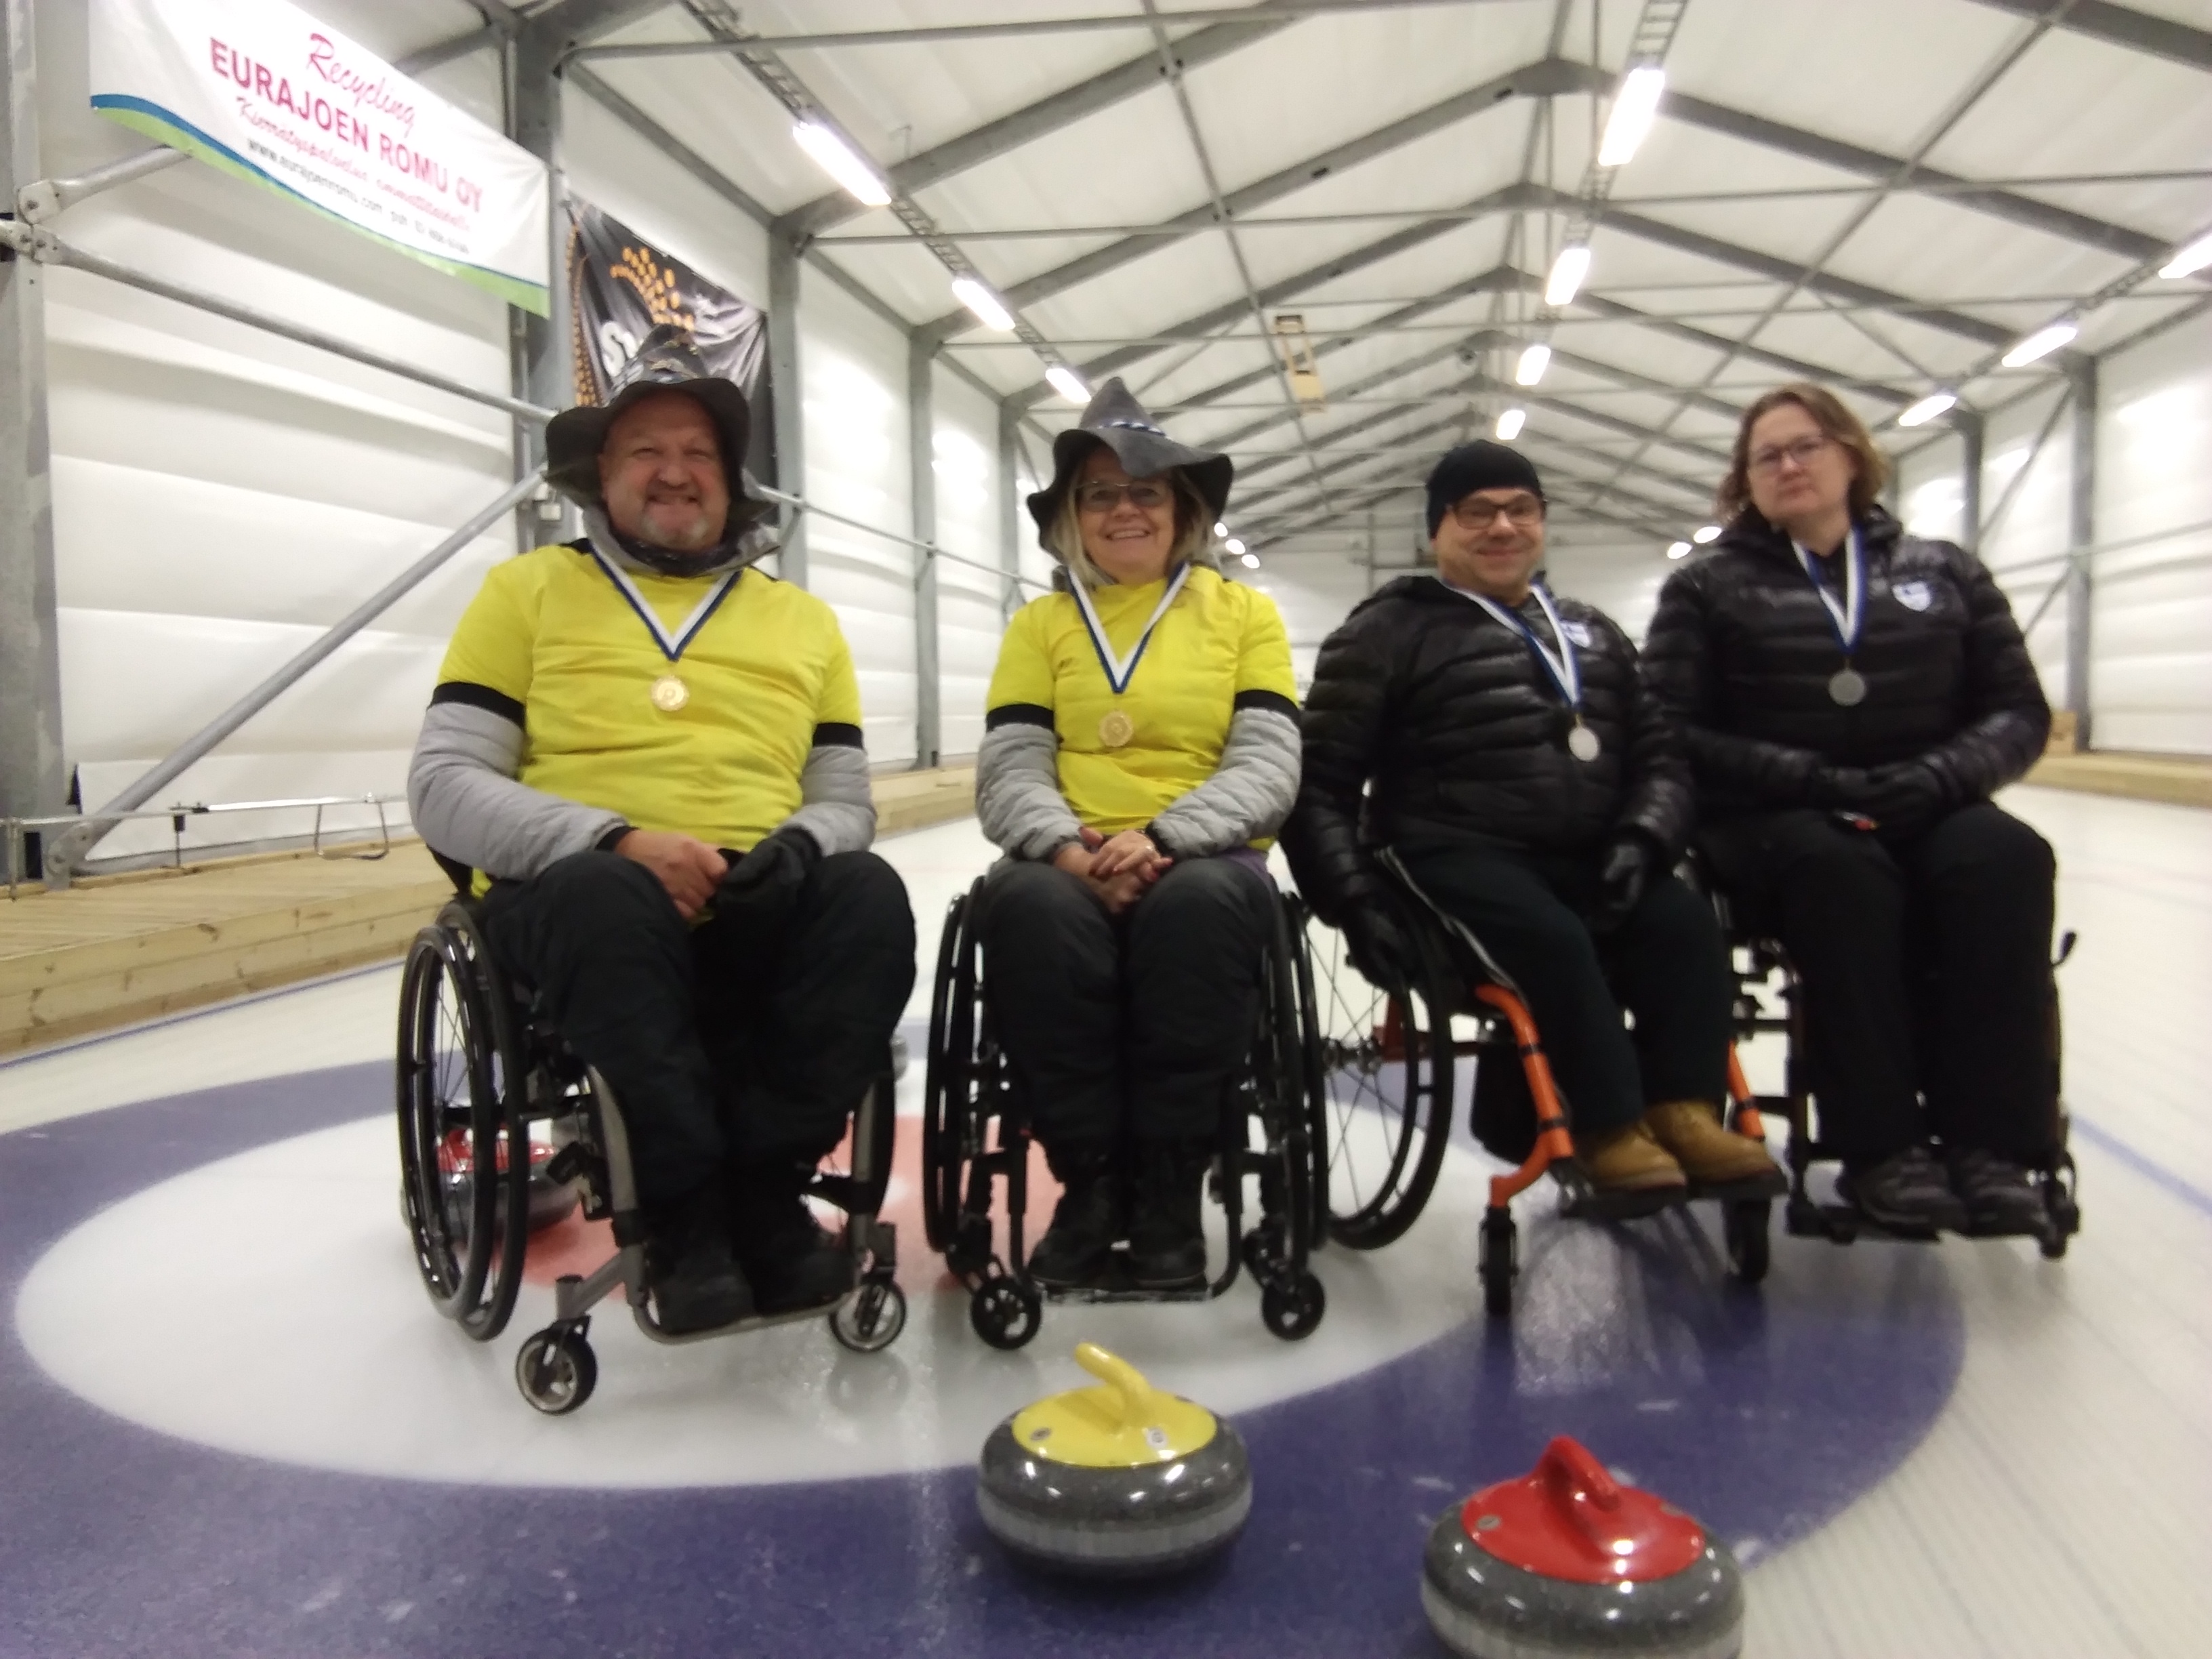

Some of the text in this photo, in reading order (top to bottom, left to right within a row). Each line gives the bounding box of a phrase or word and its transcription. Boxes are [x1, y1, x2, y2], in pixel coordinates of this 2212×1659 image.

[210, 36, 369, 153] EURAJOEN
[380, 133, 449, 194] ROMU
[456, 176, 483, 213] OY
[306, 33, 416, 138] Recycling
